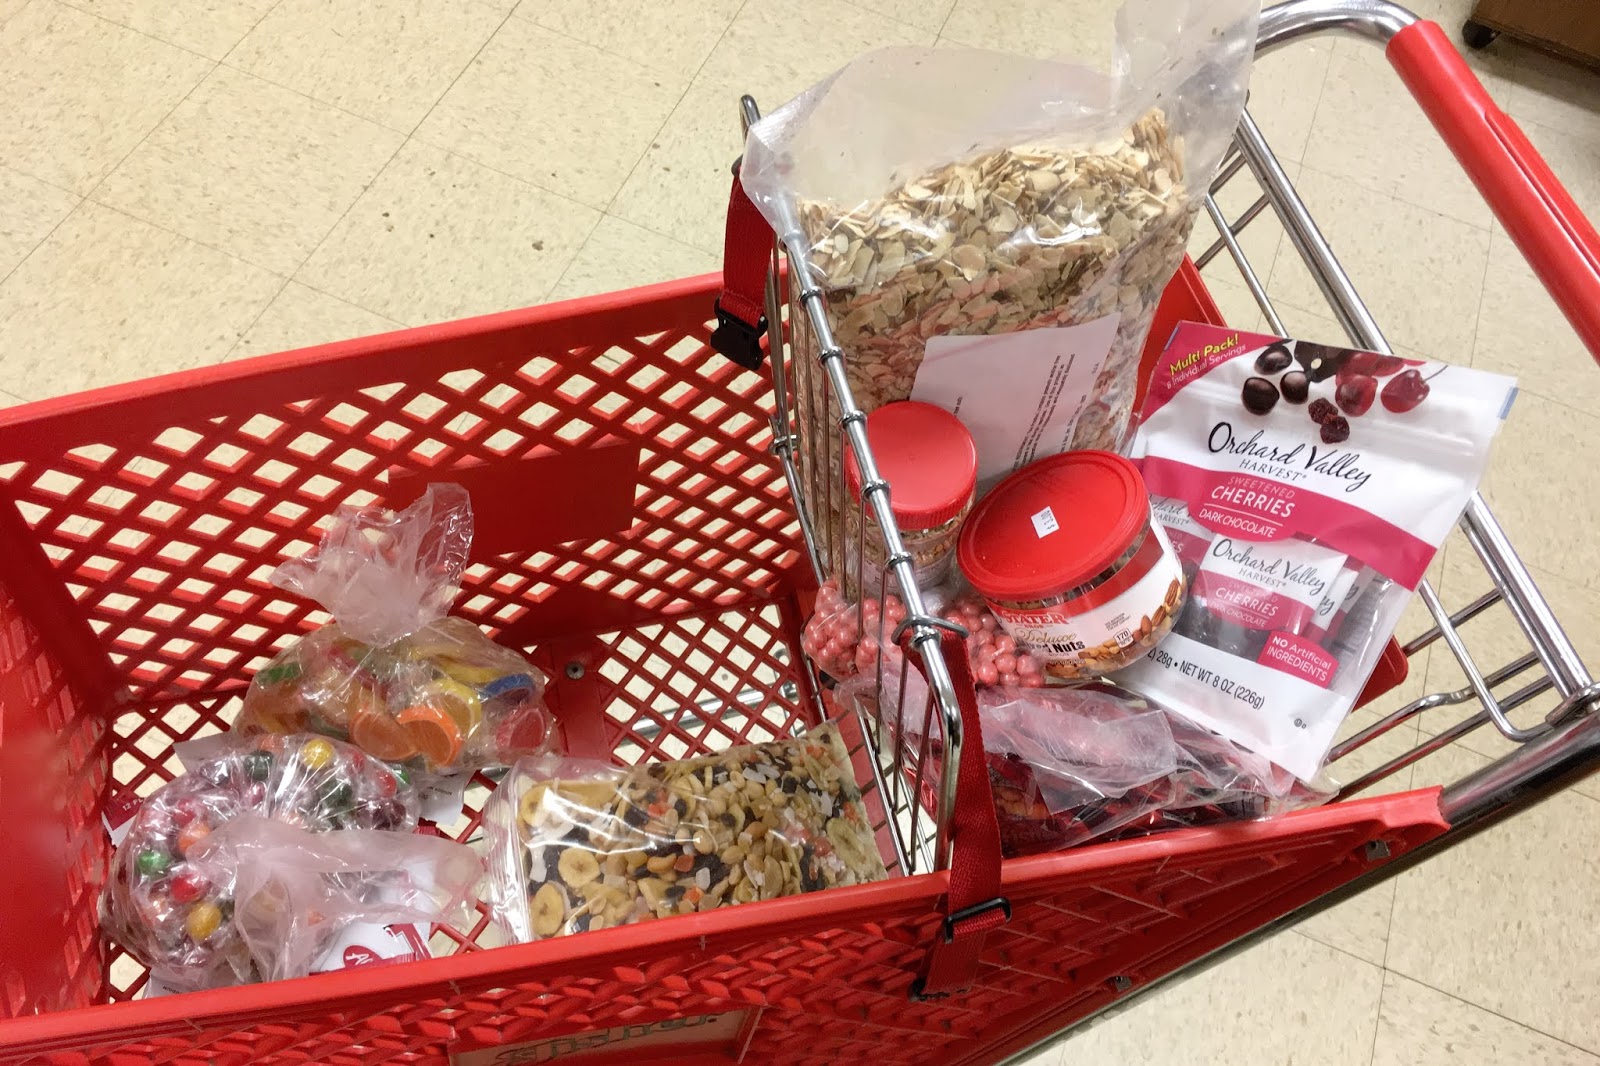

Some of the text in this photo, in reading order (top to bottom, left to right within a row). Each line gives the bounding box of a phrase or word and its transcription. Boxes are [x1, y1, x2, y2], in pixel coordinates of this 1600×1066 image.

[1169, 333, 1239, 376] Multi Pack!
[1172, 359, 1208, 386] Individual
[1208, 344, 1247, 366] Servings
[1208, 421, 1372, 493] Orchard Valley
[1211, 485, 1296, 518] CHERRIES
[1228, 475, 1296, 499] SWEETENED
[1199, 508, 1277, 538] DARK CHOCOLATE
[1213, 538, 1282, 575] Orchard
[1283, 560, 1326, 596] Valley
[1215, 587, 1279, 617] CHERRIES
[1053, 640, 1086, 653] Nuts
[1116, 631, 1129, 641] 170
[1272, 636, 1332, 669] NO Artificial
[1156, 651, 1173, 669] 28g
[1179, 660, 1198, 677] NET
[1198, 669, 1213, 684] WT
[1212, 675, 1219, 688] 8
[1220, 680, 1235, 695] OZ
[1233, 685, 1265, 710] (226g)
[1266, 646, 1328, 682] INGREDIENTS
